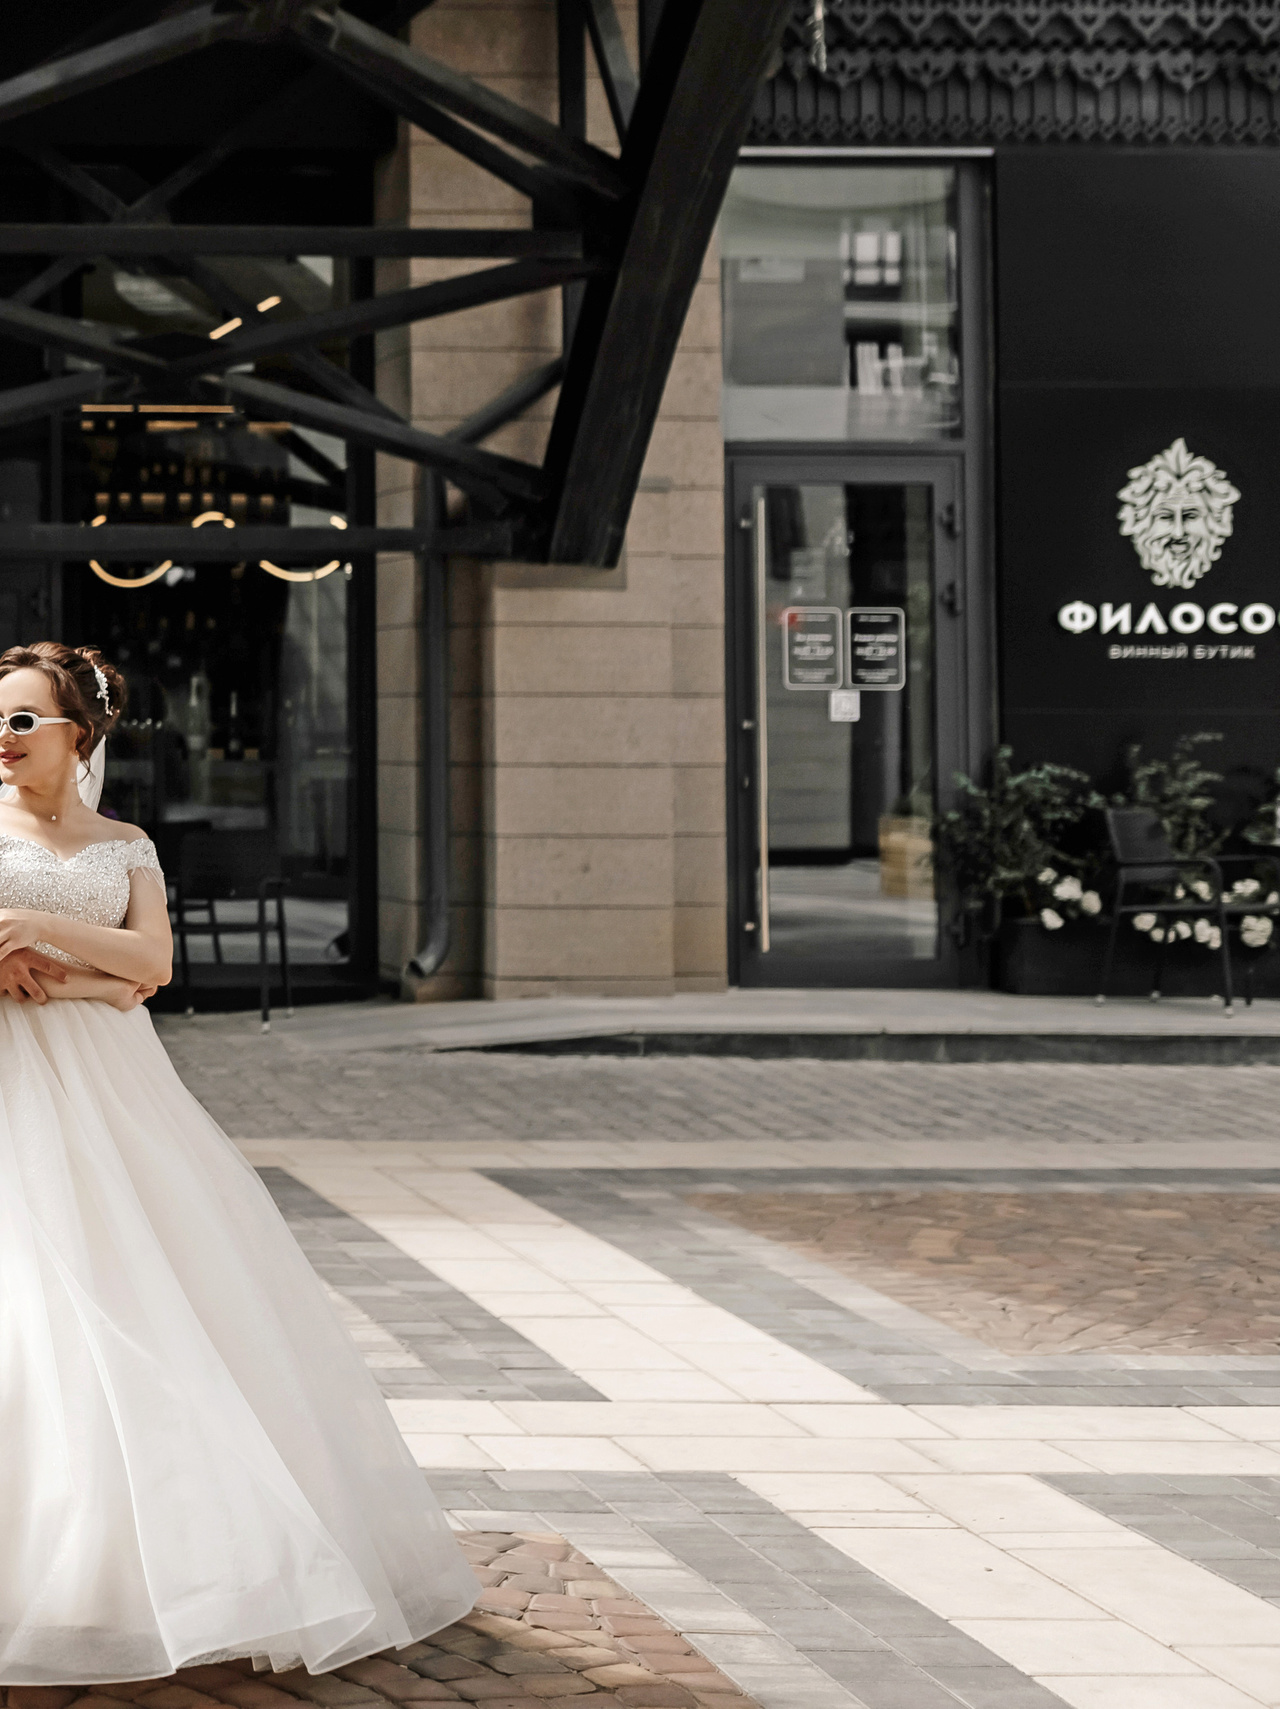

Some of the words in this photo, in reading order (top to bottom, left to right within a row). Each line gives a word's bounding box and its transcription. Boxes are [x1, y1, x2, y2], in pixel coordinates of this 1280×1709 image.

[1057, 600, 1280, 635] ФИЛОСО
[1108, 643, 1189, 660] ВИННЫЙ
[1193, 644, 1256, 660] БУТИК
